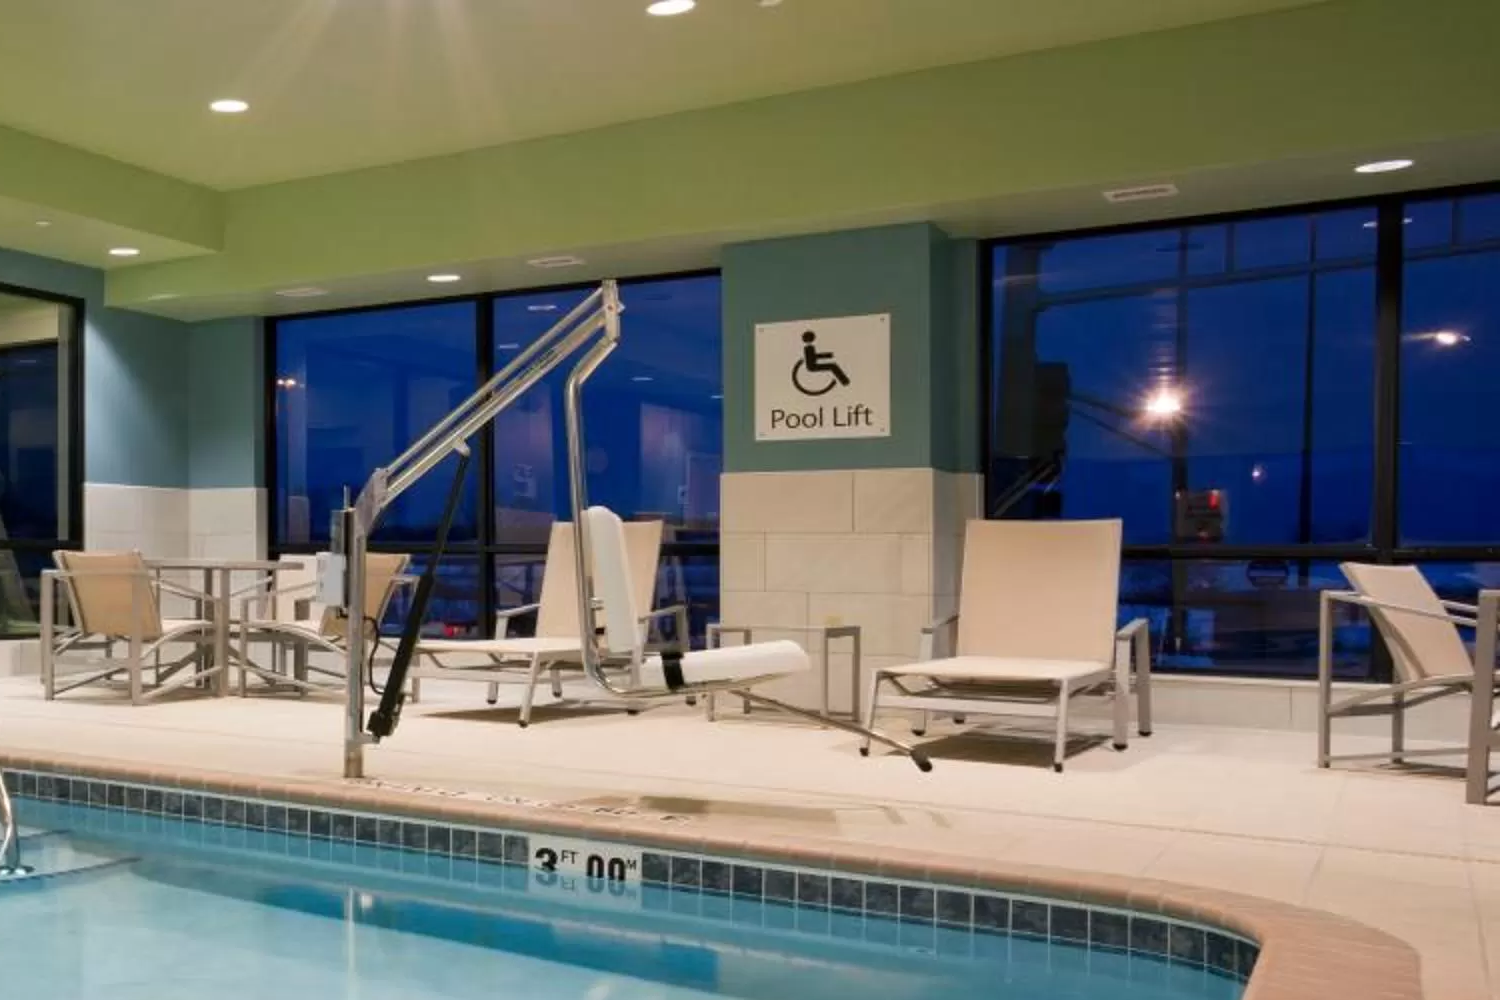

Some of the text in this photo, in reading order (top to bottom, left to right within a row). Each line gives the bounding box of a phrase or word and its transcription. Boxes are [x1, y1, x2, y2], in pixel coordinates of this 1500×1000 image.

[771, 403, 873, 429] Pool Lift
[561, 849, 580, 865] FT
